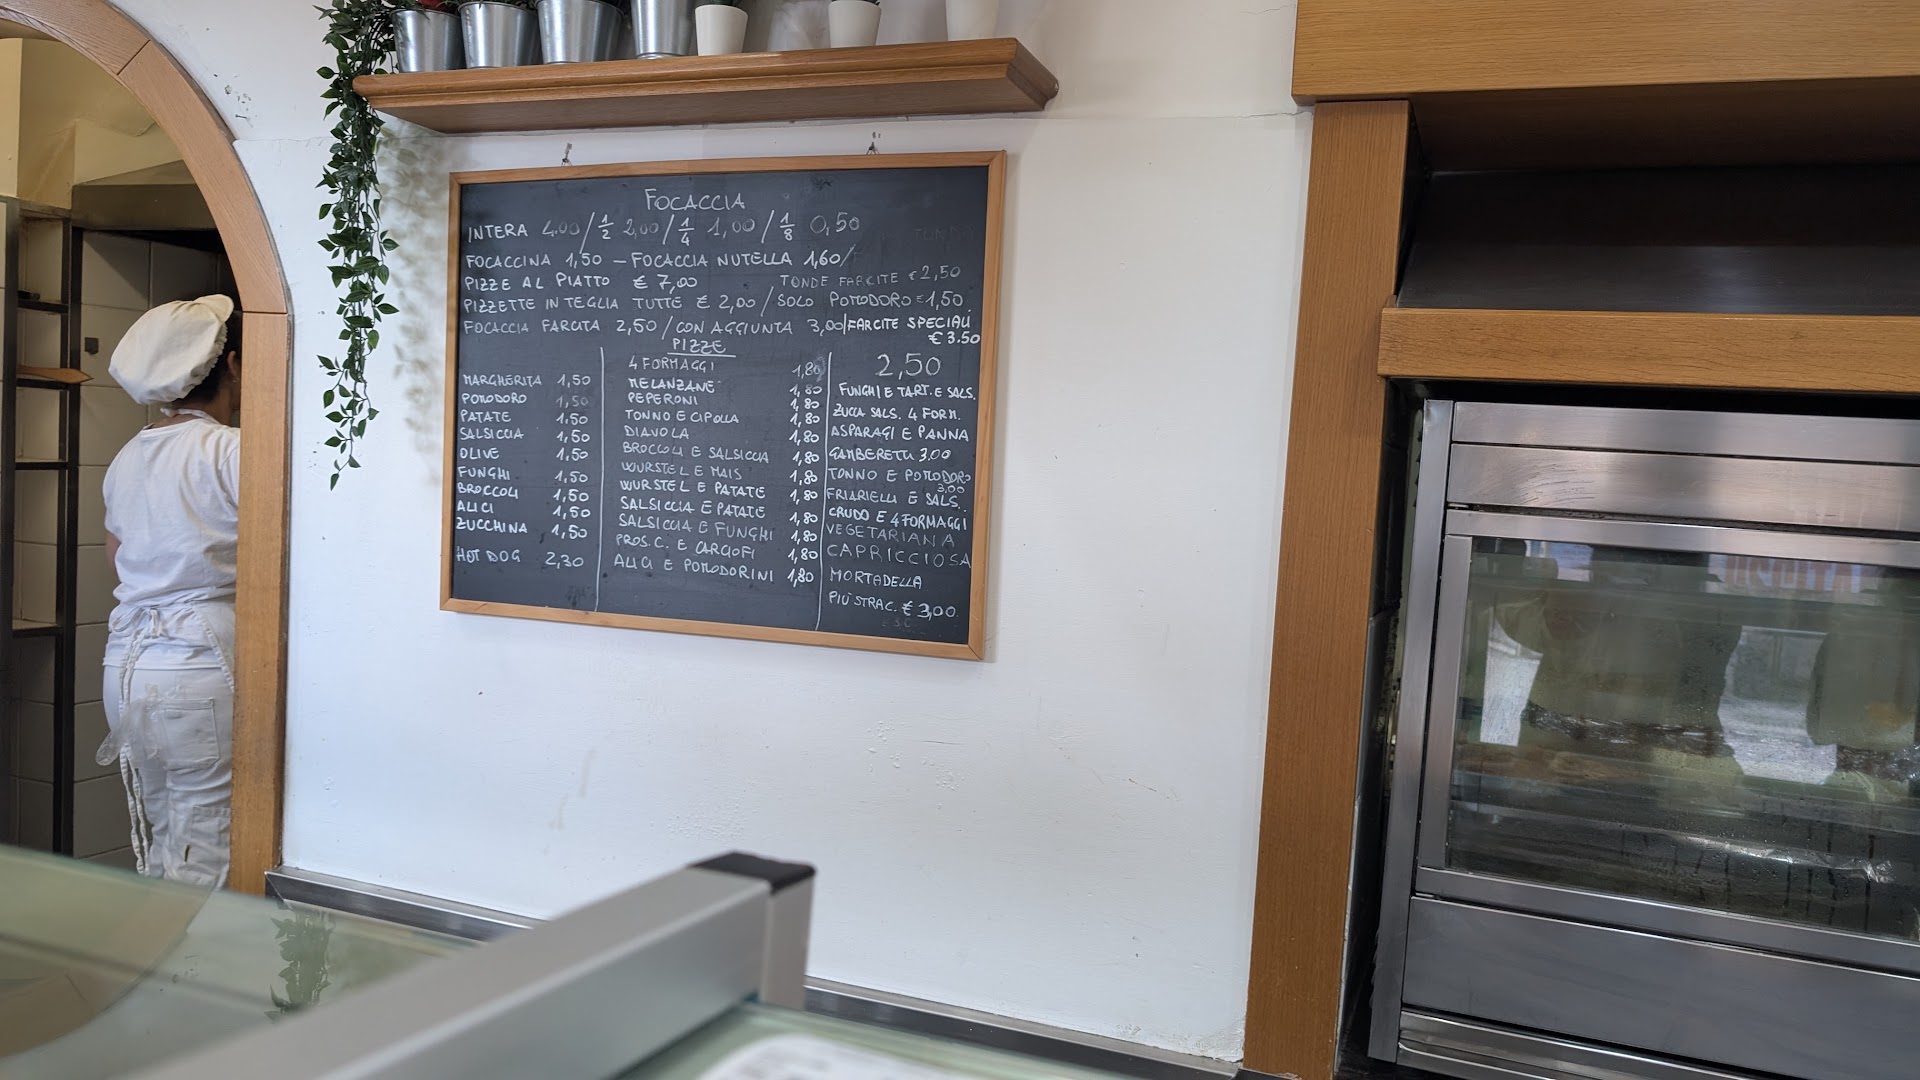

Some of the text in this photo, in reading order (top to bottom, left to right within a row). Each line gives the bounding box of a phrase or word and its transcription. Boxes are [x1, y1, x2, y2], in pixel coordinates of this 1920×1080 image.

[644, 188, 746, 211] FOCACCIA
[468, 224, 528, 243] INTERA
[466, 255, 551, 268] FOCACCINA
[566, 253, 602, 269] 1,50
[631, 252, 708, 268] FOCACCIA
[717, 252, 792, 266] NUTELLA
[464, 276, 511, 291] PIZZE
[522, 279, 544, 289] AL
[556, 272, 610, 287] PIATTO
[780, 274, 828, 288] TONDE
[839, 273, 898, 286] FARCITE
[464, 299, 535, 314] PIZZETTE
[546, 298, 559, 309] IN
[564, 297, 618, 309] TEGLIA
[632, 297, 682, 309] TUTTE
[777, 294, 813, 307] SOLO
[830, 292, 911, 307] POMODORO
[464, 321, 528, 334] FOCACCIA
[616, 319, 657, 335] 2,50
[676, 321, 704, 334] CON
[711, 320, 793, 335] AGGIUNTA
[672, 338, 726, 354] PIZZE
[629, 355, 638, 370] 4
[643, 357, 714, 373] FORMAGGI
[875, 353, 941, 380] 2,50
[463, 374, 591, 388] MARGHERITA 1,50
[628, 378, 715, 393] MELANZANE
[839, 382, 880, 399] FUNGHI
[885, 387, 893, 397] E
[935, 388, 942, 397] E
[461, 393, 589, 408] POMODORO 1,50
[628, 392, 819, 411] PEPERONI 1,80
[460, 409, 588, 425] PATATE 1,50
[625, 409, 820, 427] TONNO E CIPOLLA 1,80
[833, 403, 865, 417] ZUCCA
[908, 408, 917, 421] 4
[460, 427, 590, 443] SALSICCIA 1,50
[624, 425, 819, 446] DIAVOLA 1,80
[831, 424, 969, 441] ASPARAGI E PANNA
[460, 447, 588, 460] OLIVE 1,50
[623, 442, 819, 466] BROCCOLI E SALSICCIA 1,80
[457, 466, 588, 483] FUNGHI 1,50
[621, 462, 817, 485] WURSTEL E MAIS 1,80
[828, 468, 971, 484] TONNO E POMODORO
[457, 483, 589, 502] BROCCOLI 1,50
[620, 480, 818, 504] WURSTEL E PATATE 1,80
[908, 491, 918, 505] E
[457, 500, 590, 520] ALICI 1,50
[620, 496, 818, 526] SALSICCIA E PATATE 1,80
[829, 506, 869, 521] CRUDO
[876, 511, 887, 523] E
[902, 513, 967, 531] FORMAGGI
[456, 517, 587, 539] ZUCCHINA 1,50
[619, 513, 817, 544] SALSICCIA E FUNGHI 1,80
[826, 523, 955, 547] VEGETARIANA
[457, 546, 584, 569] HOT DOG 2,30
[678, 539, 687, 550] E
[788, 548, 818, 564] 1,80
[827, 544, 971, 568] CAPRICCIOSA
[614, 554, 813, 587] ALICI E POMODORINI 1,80
[830, 567, 922, 589] MORTADELLA
